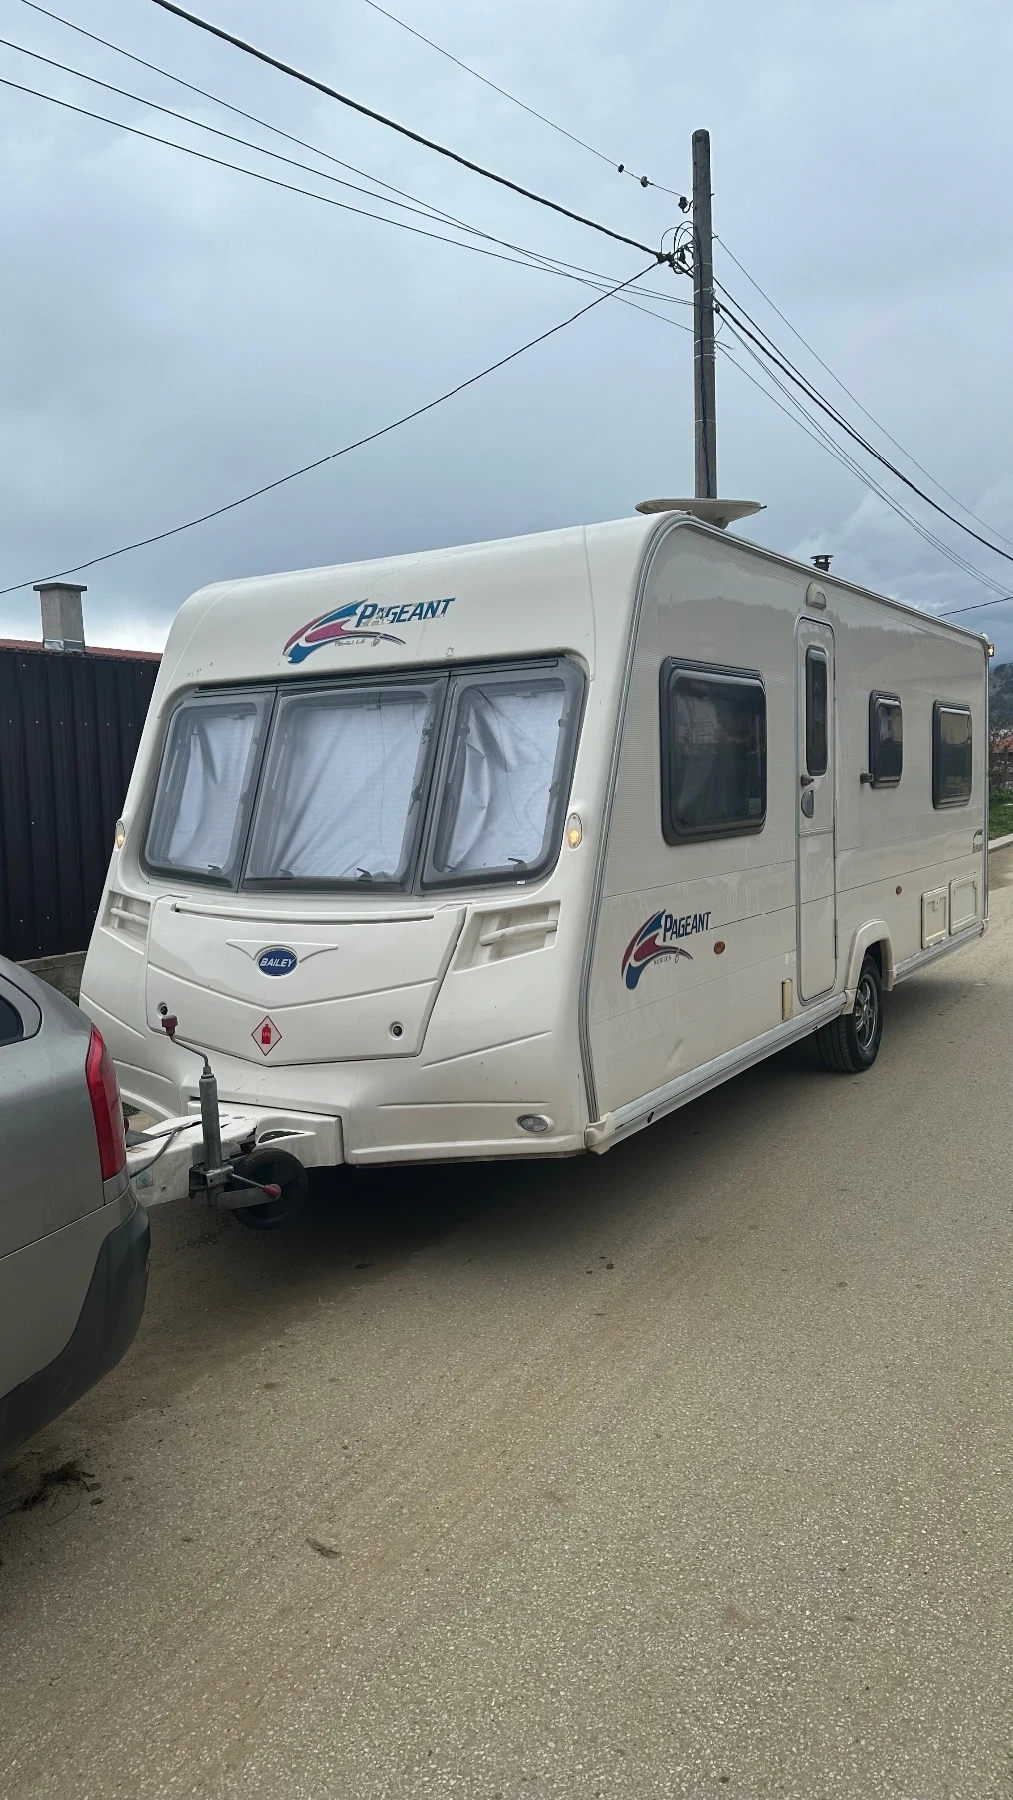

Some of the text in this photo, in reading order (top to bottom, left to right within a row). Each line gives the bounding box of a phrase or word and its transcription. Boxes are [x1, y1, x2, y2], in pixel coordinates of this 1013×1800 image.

[355, 598, 456, 628] PAGEANT
[663, 911, 711, 942] PAGEANT
[260, 957, 294, 967] BAILEY
[653, 955, 672, 965] SERIES
